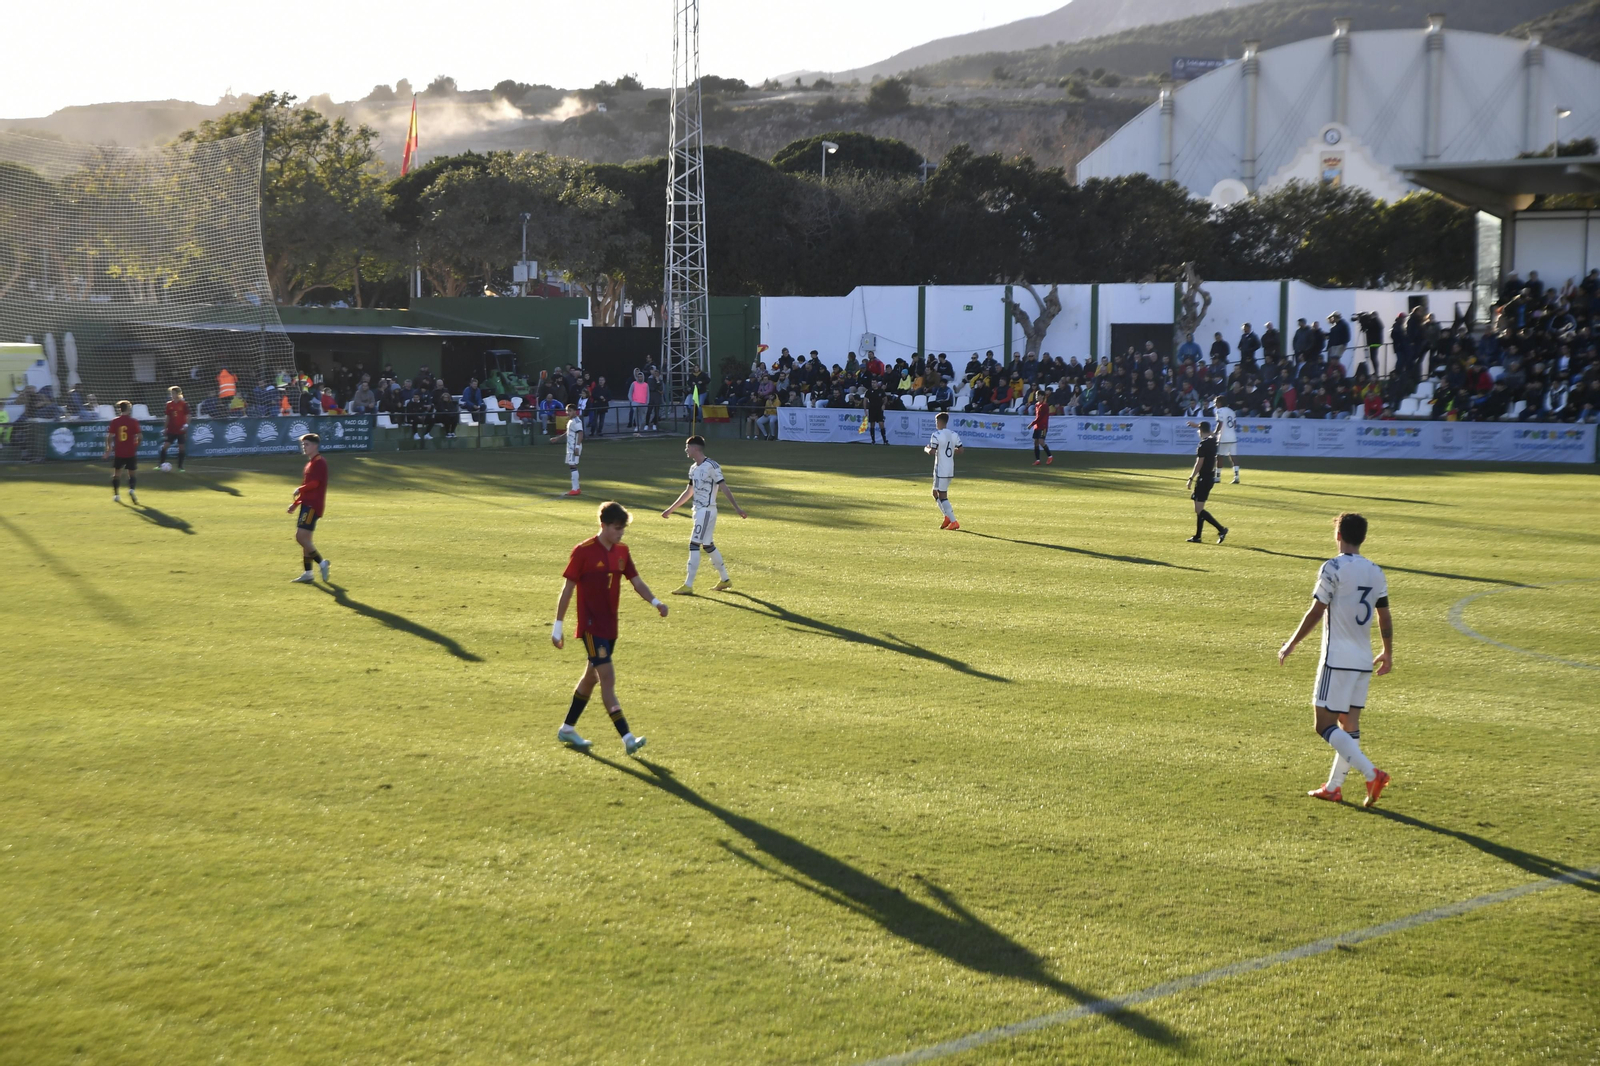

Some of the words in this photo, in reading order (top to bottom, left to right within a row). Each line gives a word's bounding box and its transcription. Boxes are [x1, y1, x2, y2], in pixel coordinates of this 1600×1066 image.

[118, 425, 129, 442] 6
[1077, 434, 1133, 442] TORREMOLINOS
[945, 441, 953, 458] 6
[607, 572, 614, 589] 7
[1355, 585, 1373, 626] 3
